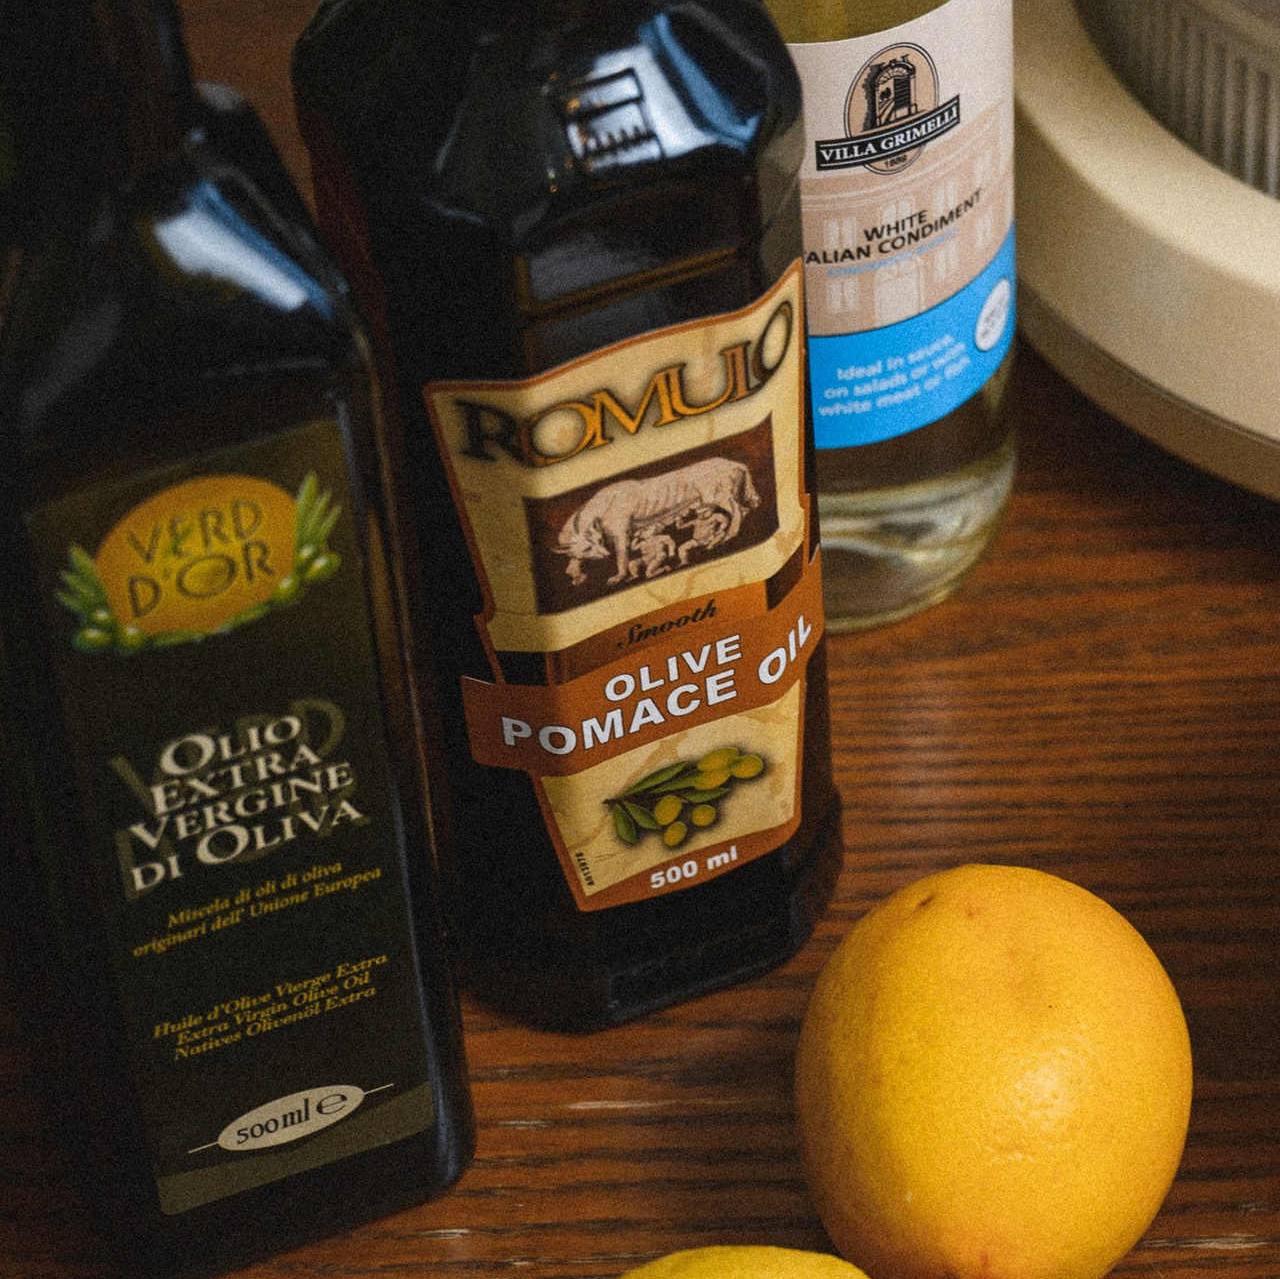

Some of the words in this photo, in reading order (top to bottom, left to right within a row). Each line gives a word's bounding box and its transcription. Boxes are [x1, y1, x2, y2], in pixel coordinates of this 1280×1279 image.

[819, 142, 878, 162] VILLA
[880, 104, 959, 151] GRIMELLI
[863, 209, 928, 242] WHITE
[877, 187, 982, 254] CONDIMENT
[455, 299, 794, 468] ROMULO
[823, 386, 849, 400] on
[853, 372, 909, 397] salads
[836, 359, 883, 381] Ideal
[886, 355, 905, 371] in
[818, 399, 873, 417] white
[127, 499, 262, 564] VERD
[128, 540, 277, 619] D'OR
[616, 598, 719, 651] Smooth
[501, 668, 739, 757] POMACE
[757, 614, 813, 686] OIL
[604, 633, 743, 704] OLIVE
[130, 761, 354, 850] VERGINE
[150, 743, 322, 816] EXTRA
[130, 854, 185, 892] DI
[196, 799, 364, 865] OLIVA
[649, 859, 699, 890] 500
[706, 845, 739, 871] ml
[132, 922, 207, 958] originari
[210, 908, 246, 932] dell'
[249, 889, 310, 919] Unione
[313, 866, 383, 899] Europea
[167, 897, 231, 929] Miscela
[233, 888, 252, 906] di
[255, 879, 277, 898] oli
[279, 872, 299, 891] di
[301, 862, 344, 884] oliva
[153, 1013, 203, 1039] Huile
[206, 992, 272, 1022] d'Olive
[275, 972, 332, 997] Vierge
[335, 954, 389, 980] Extra
[173, 1031, 242, 1062] Natives
[245, 1002, 321, 1038] Olivenöl
[324, 985, 378, 1012] Extra
[176, 1021, 230, 1046] Extra
[233, 1002, 289, 1028] Virgin
[292, 983, 340, 1007] Olive
[342, 970, 371, 990] Oil
